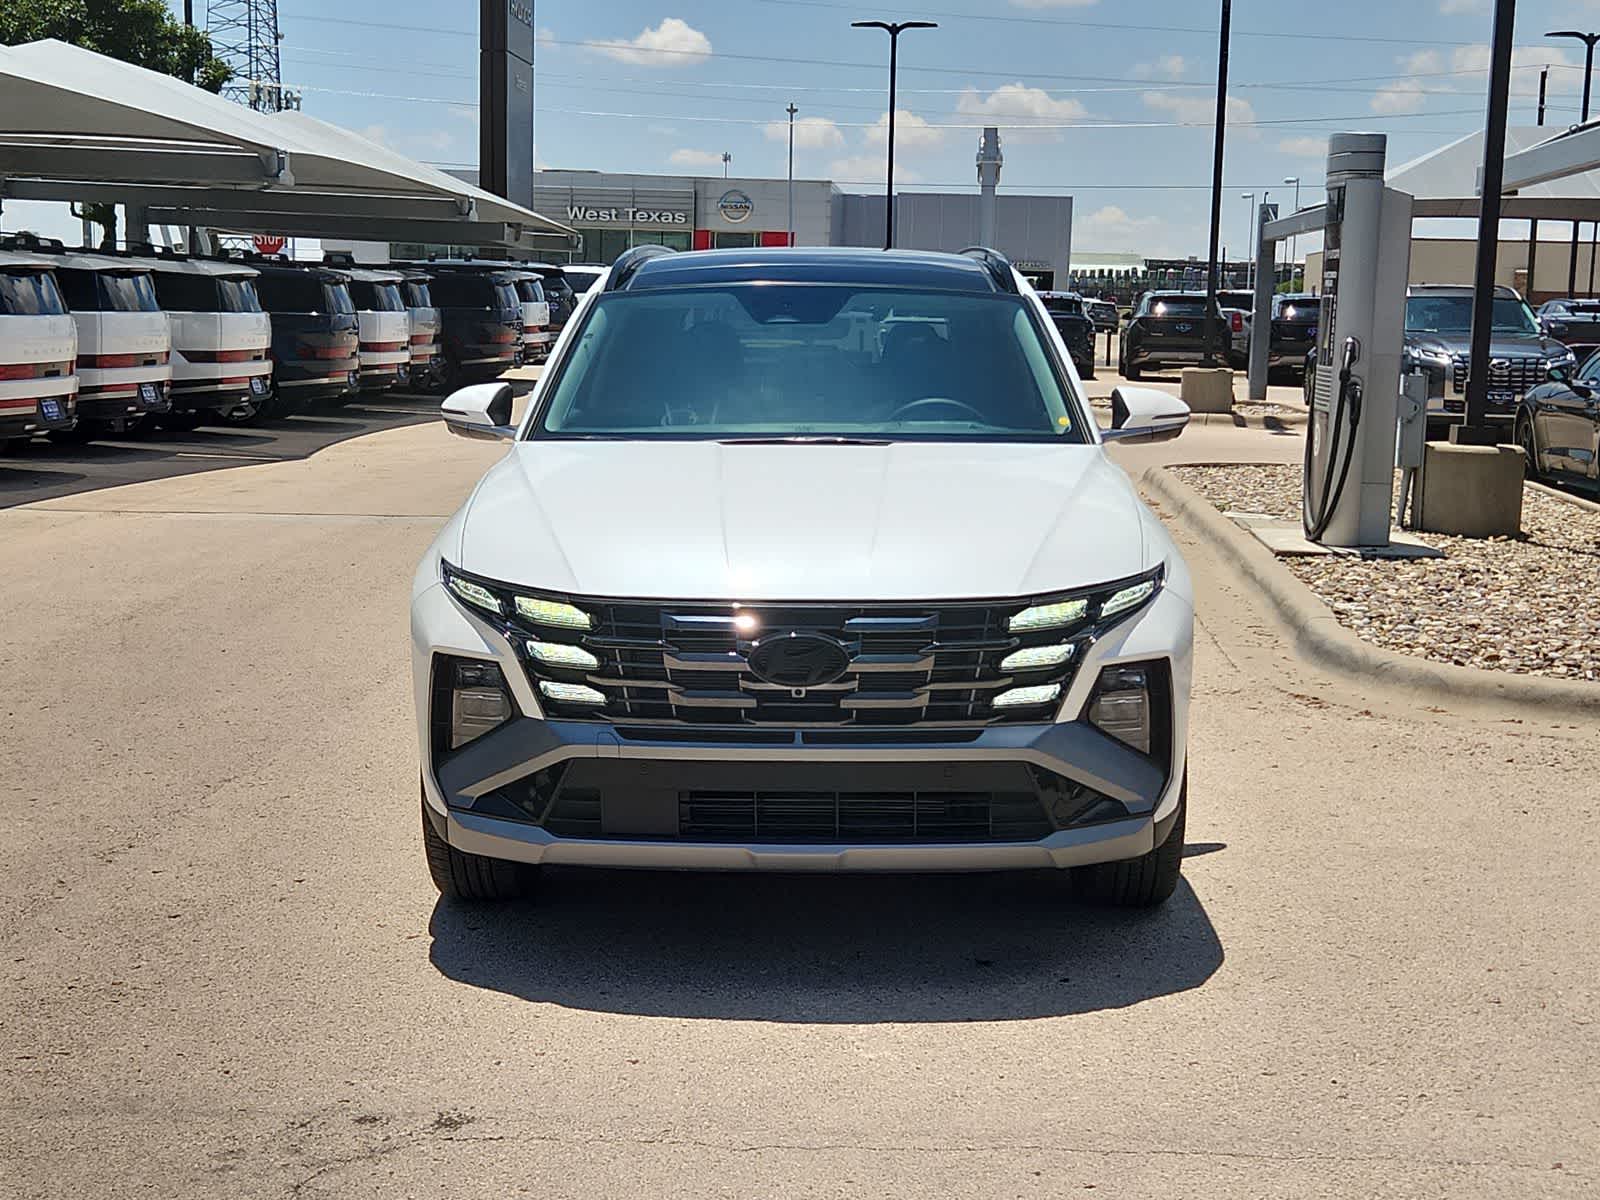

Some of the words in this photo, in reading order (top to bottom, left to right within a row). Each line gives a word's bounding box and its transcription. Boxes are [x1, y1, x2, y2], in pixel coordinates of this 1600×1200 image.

[566, 206, 618, 222] West
[624, 207, 687, 224] Texas
[255, 235, 282, 245] STOP
